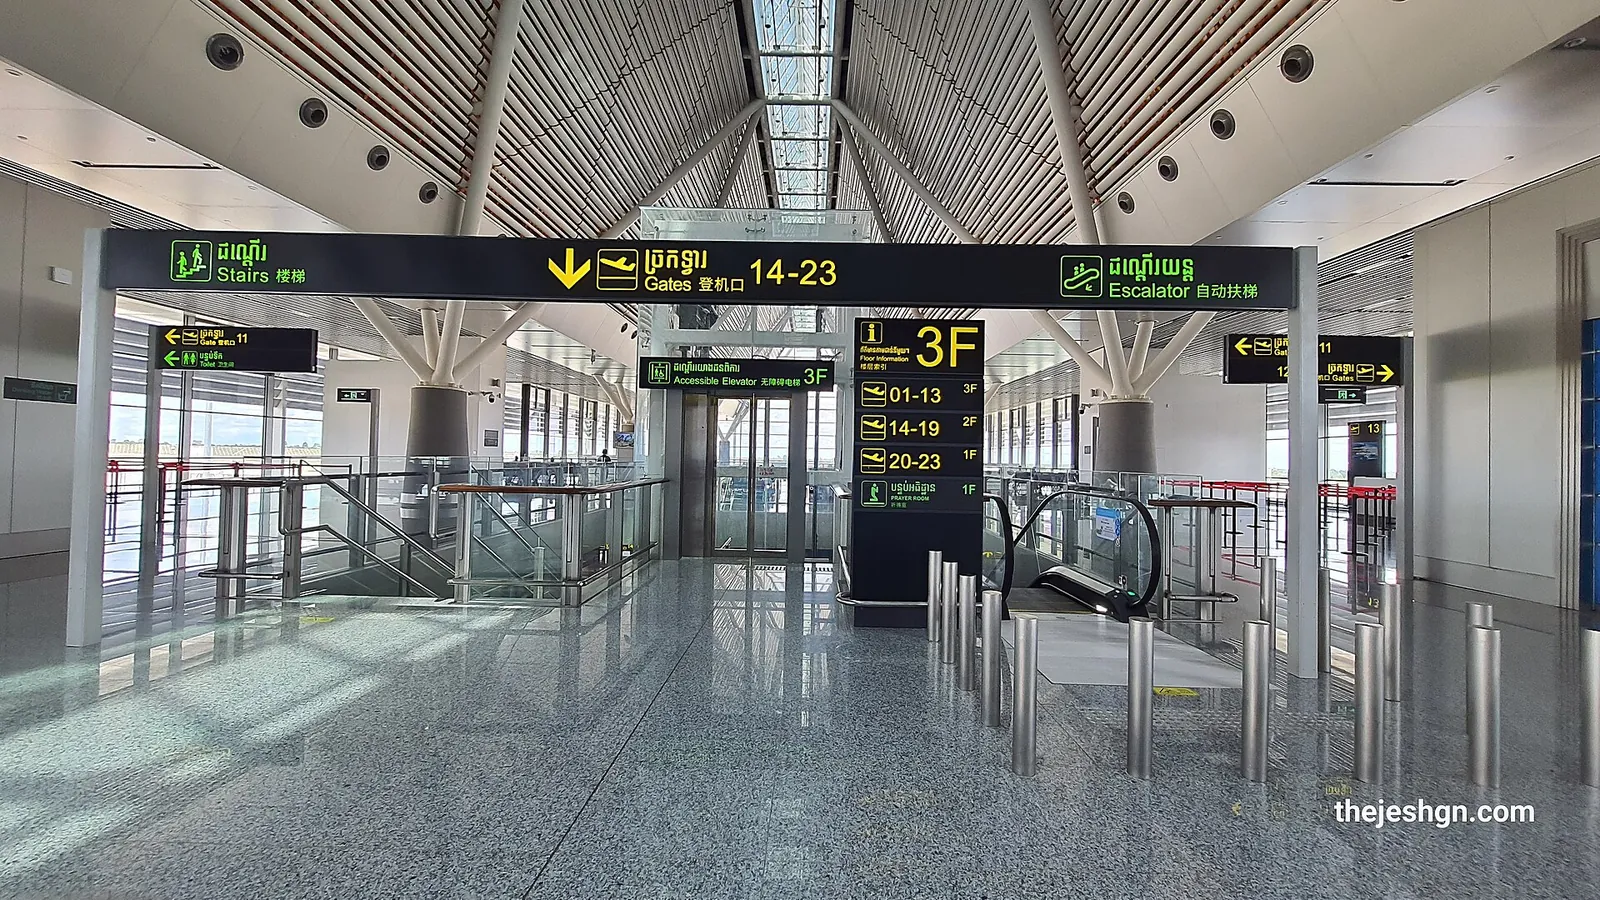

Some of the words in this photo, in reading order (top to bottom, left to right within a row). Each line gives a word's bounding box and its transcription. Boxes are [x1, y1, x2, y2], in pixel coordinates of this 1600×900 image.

[218, 267, 269, 282] Stairs
[276, 268, 306, 284] 楼梯
[750, 258, 837, 286] 14-23
[645, 276, 692, 292] Gates
[698, 277, 744, 292] 登机口
[1110, 283, 1190, 298] Escalator
[1197, 283, 1258, 298] 自动扶梯
[236, 333, 248, 344] 11
[916, 326, 978, 368] 3F
[1319, 342, 1331, 354] 11
[674, 376, 719, 385] Accessible
[722, 377, 757, 386] Elevator
[760, 378, 800, 387] 无障碍电梯
[804, 368, 828, 384] 3F
[890, 387, 941, 403] 01-13
[963, 384, 978, 393] 3F
[889, 420, 940, 436] 14-19
[963, 416, 977, 426] 2F
[1368, 423, 1380, 433] 13
[889, 454, 941, 470] 20-23
[963, 450, 977, 460] 1F
[962, 484, 976, 494] 1F
